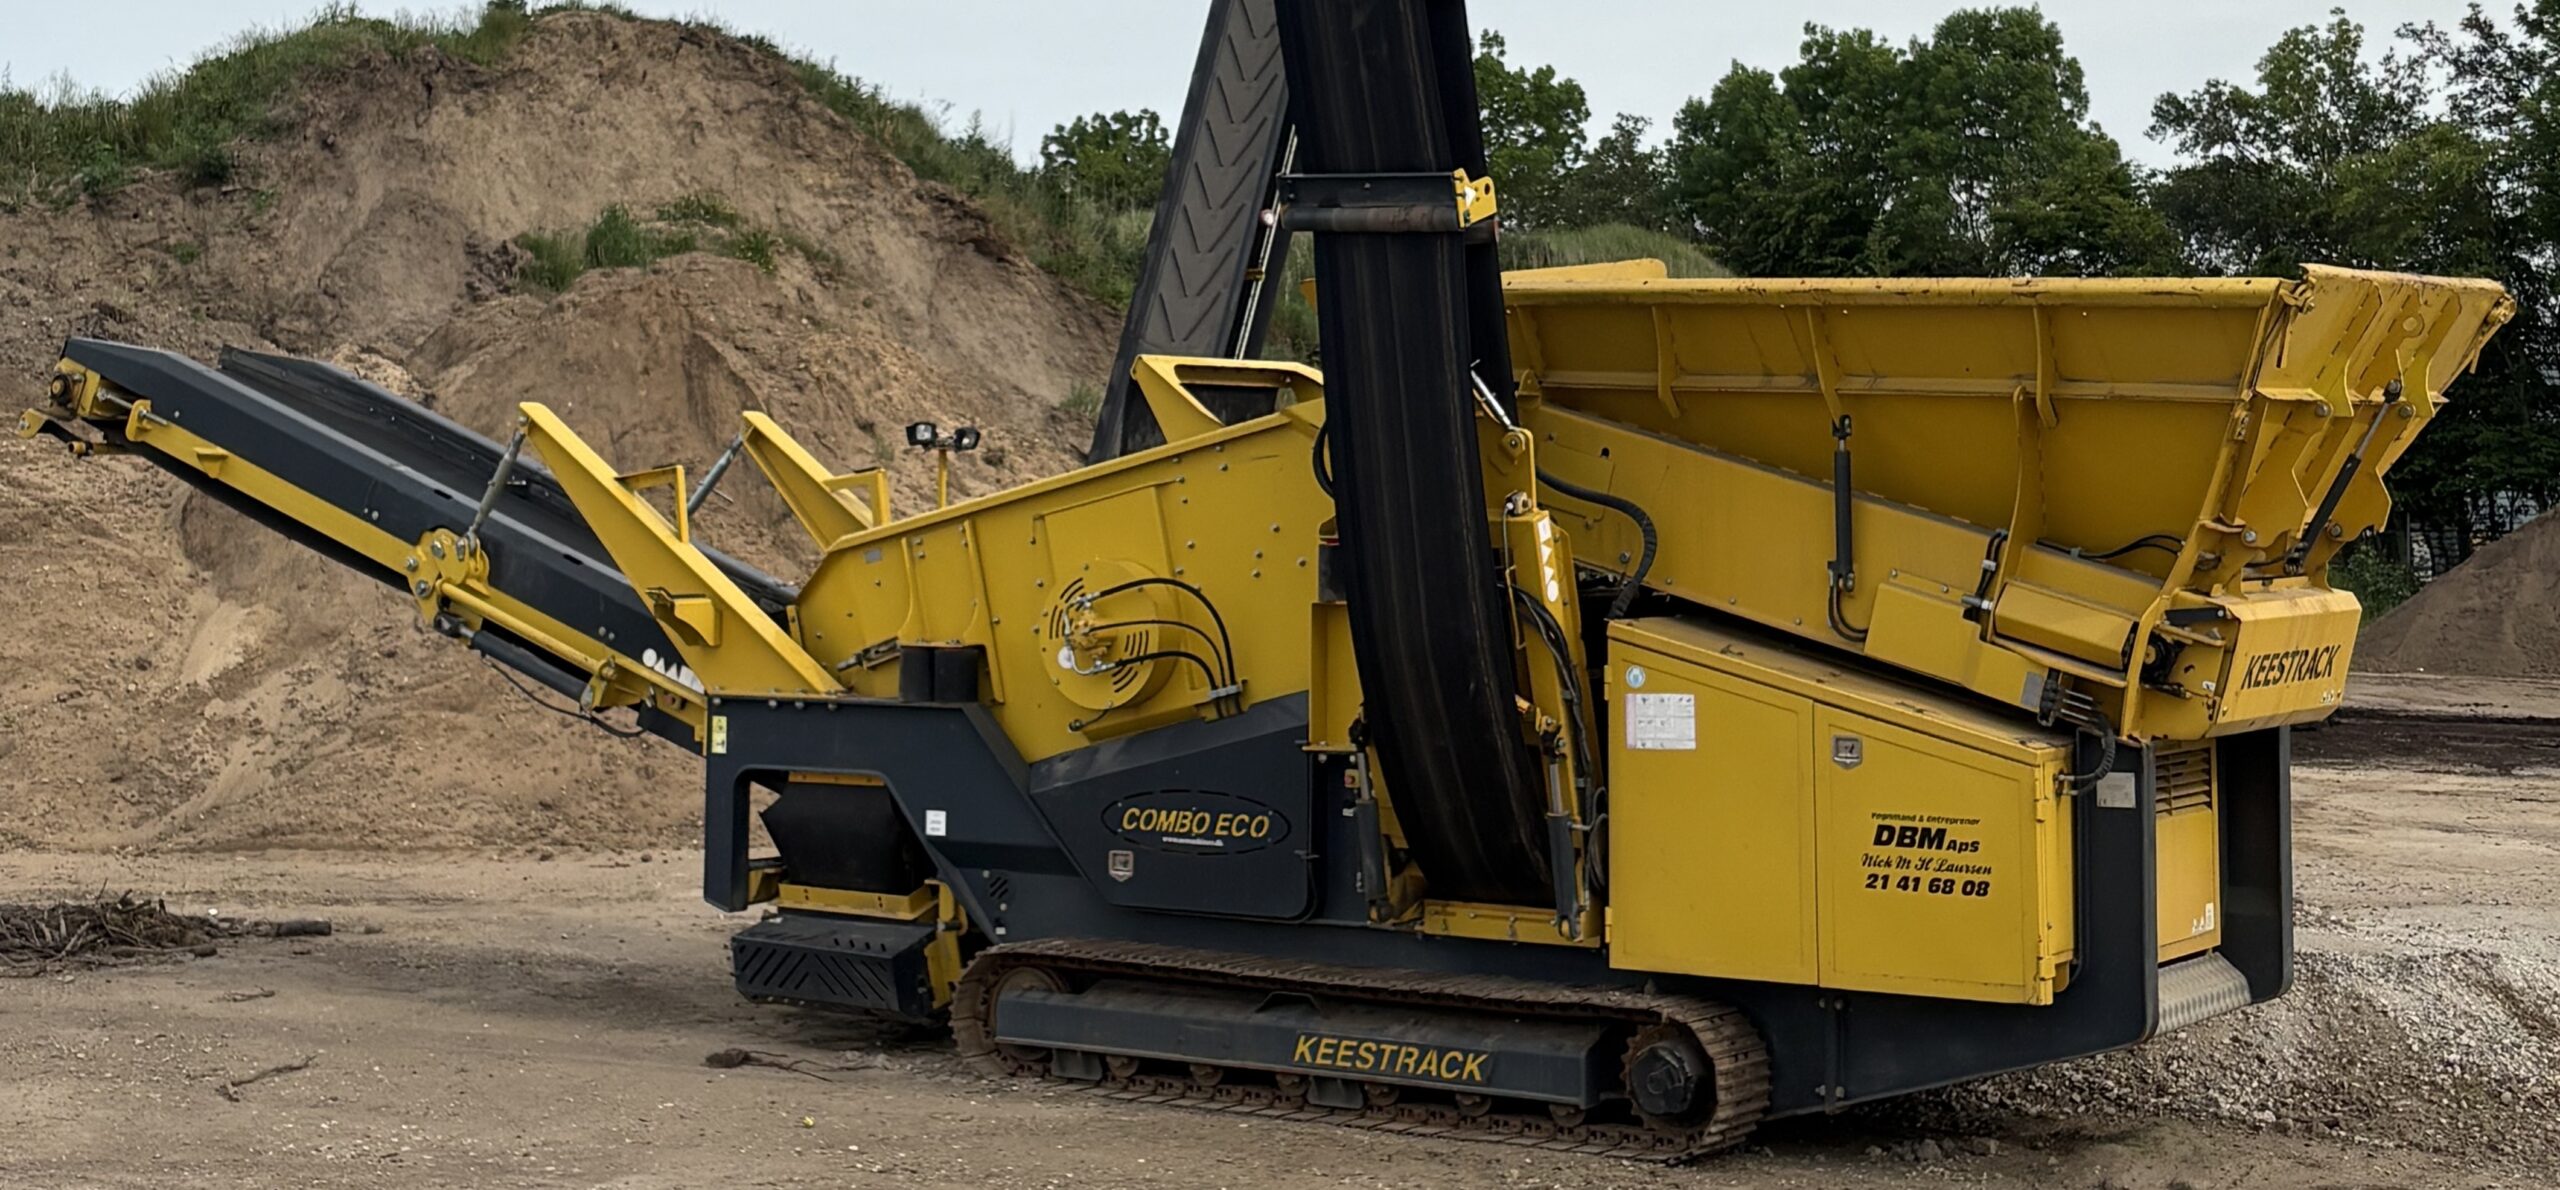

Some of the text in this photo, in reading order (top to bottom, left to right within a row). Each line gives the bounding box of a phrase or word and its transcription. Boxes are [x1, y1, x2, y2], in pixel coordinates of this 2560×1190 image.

[2241, 644, 2341, 690] KEESTRACK
[1122, 807, 1270, 838] COMBO ECO
[1873, 824, 1980, 854] DBM ApS
[1862, 853, 1892, 869] Nick
[1895, 856, 1912, 870] M
[1933, 858, 1992, 875] Laursen
[1865, 873, 1990, 897] 21 41 68 08
[1293, 1035, 1489, 1082] KEESTRACK
